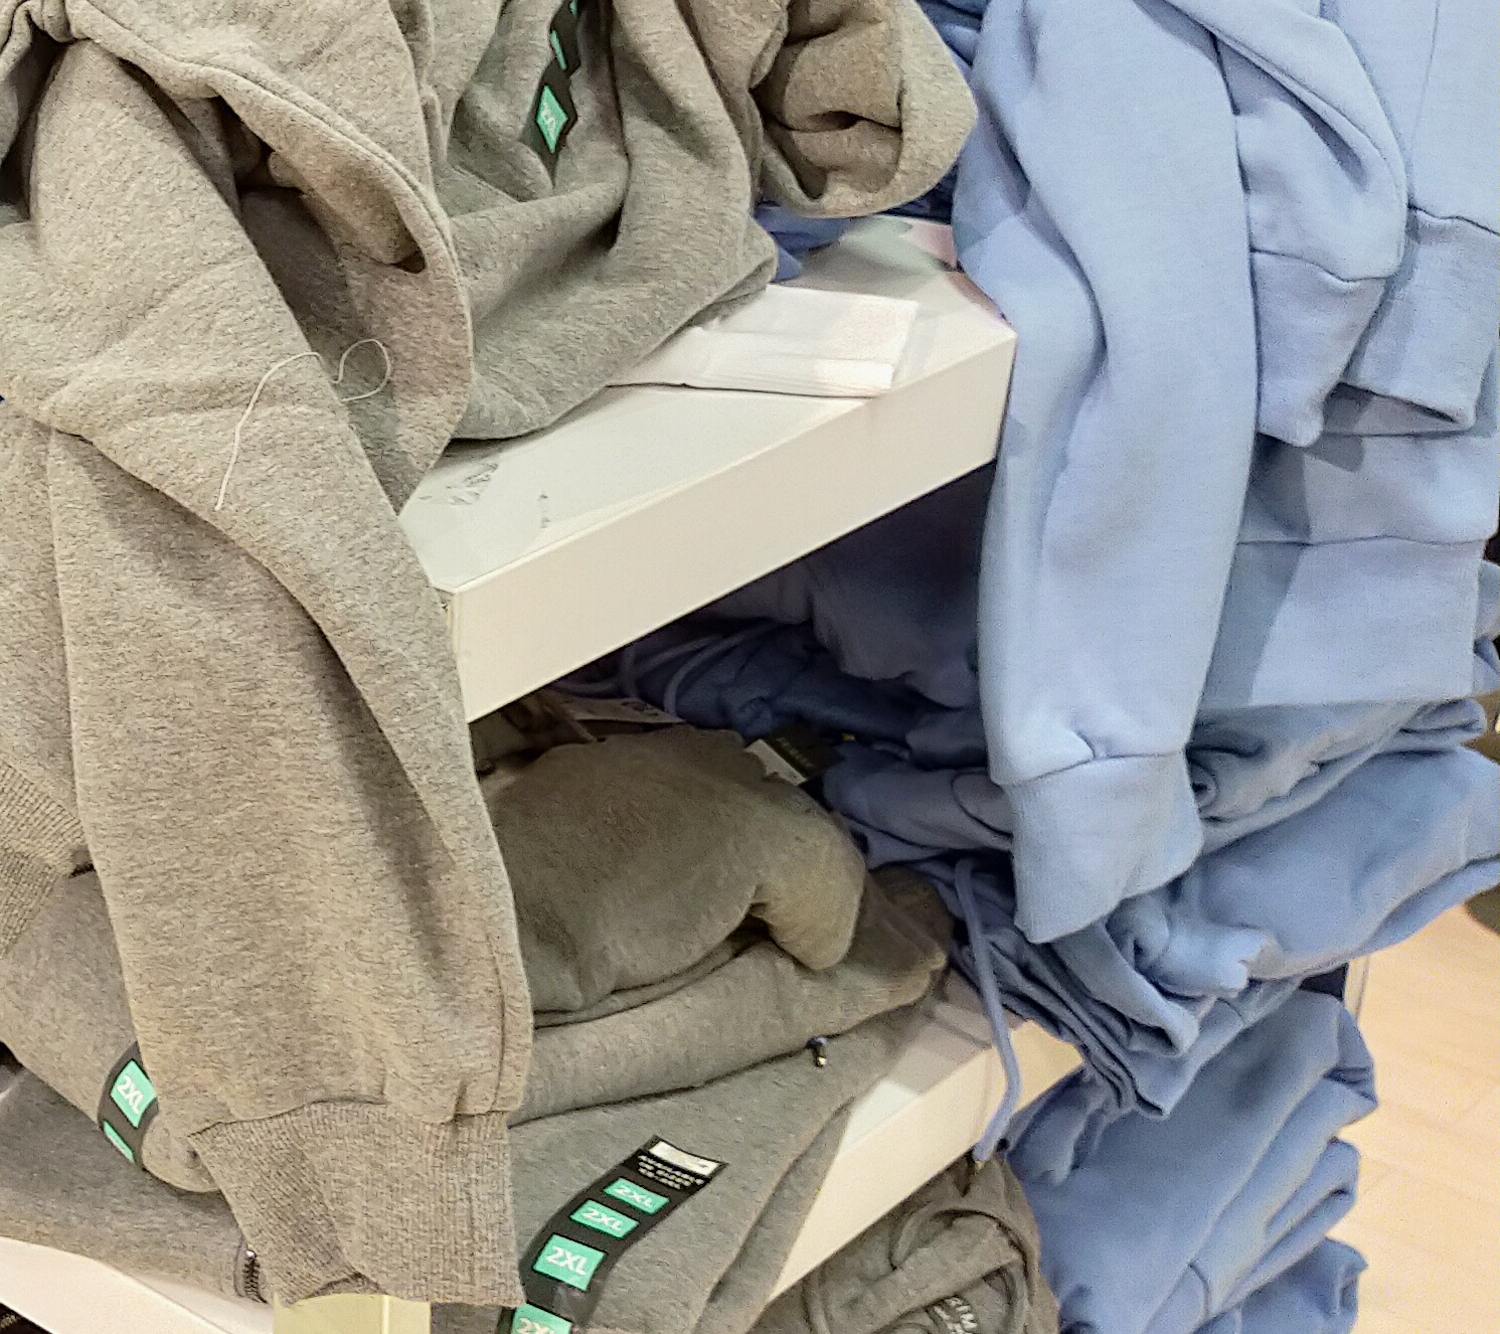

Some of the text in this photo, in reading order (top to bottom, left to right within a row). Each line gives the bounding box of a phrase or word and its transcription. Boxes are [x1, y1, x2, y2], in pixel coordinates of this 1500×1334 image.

[117, 1074, 145, 1115] 2XL
[613, 1185, 653, 1207] 2XL
[581, 1207, 623, 1232] 2XL
[545, 1245, 587, 1276] 2XL
